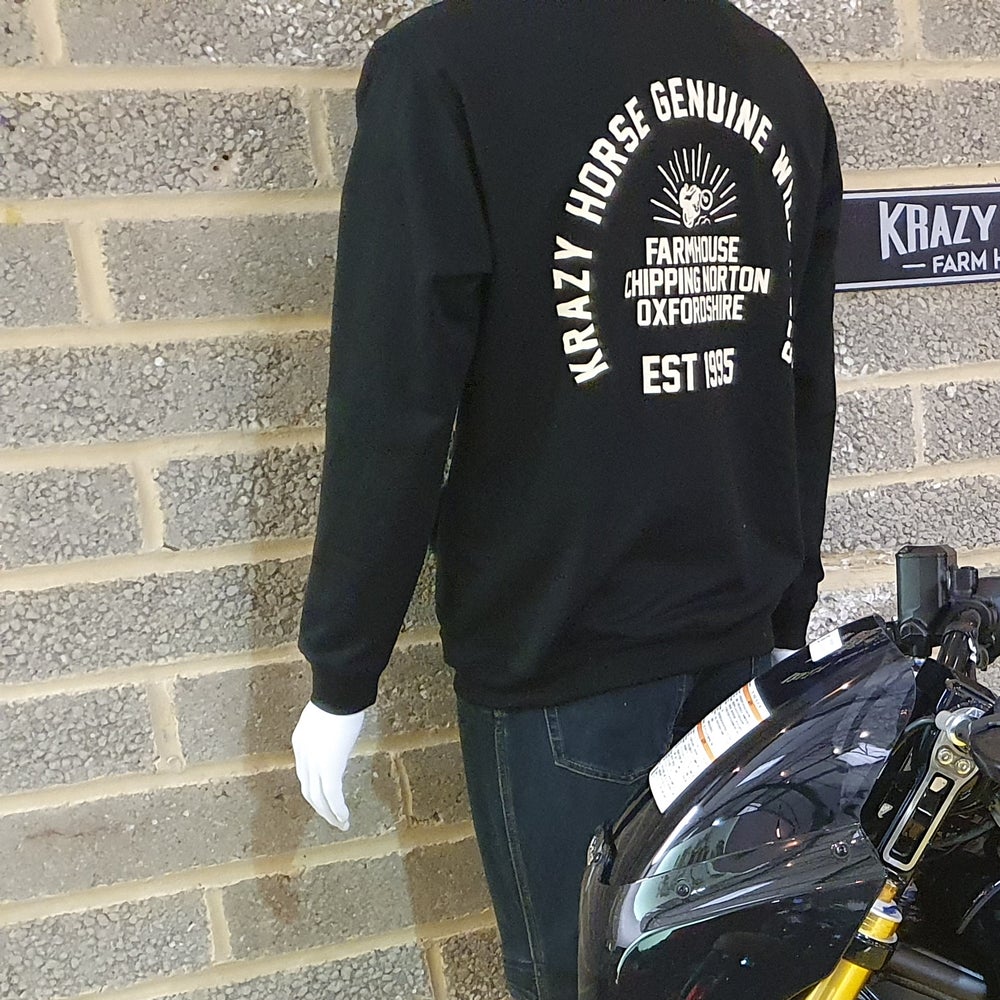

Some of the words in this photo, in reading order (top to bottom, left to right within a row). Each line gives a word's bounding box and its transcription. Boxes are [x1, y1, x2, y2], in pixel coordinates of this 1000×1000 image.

[650, 77, 773, 154] GENUINE
[565, 96, 651, 226] HORSE
[645, 236, 740, 266] FARMHOUSE
[878, 200, 998, 260] KRAZY
[624, 268, 702, 299] CHIPPING
[701, 265, 771, 295] NORTON
[932, 249, 987, 274] FARM
[553, 235, 609, 385] KRAZY
[636, 293, 745, 327] OXFORDSHIRE
[641, 352, 699, 394] EST
[703, 347, 736, 389] 1995
